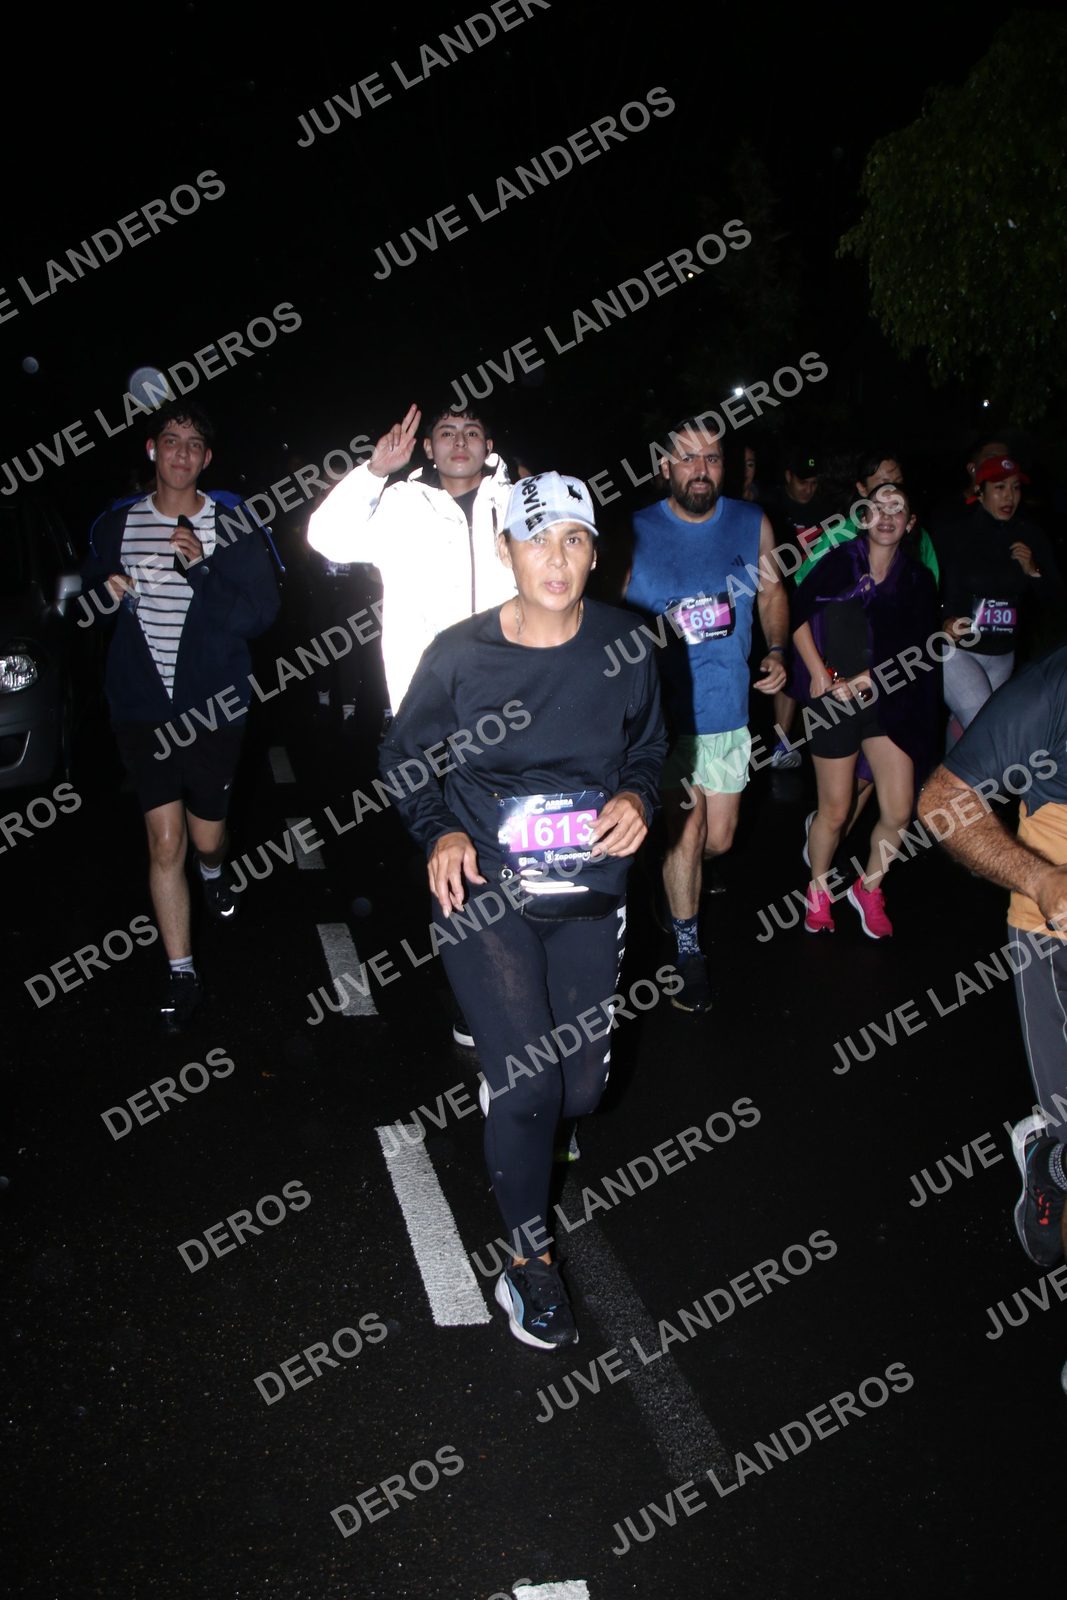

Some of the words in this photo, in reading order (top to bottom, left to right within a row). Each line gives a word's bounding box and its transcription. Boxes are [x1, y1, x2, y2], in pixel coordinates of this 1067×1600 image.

[690, 608, 716, 629] 69
[985, 609, 1012, 624] 130
[515, 812, 595, 849] 1613
